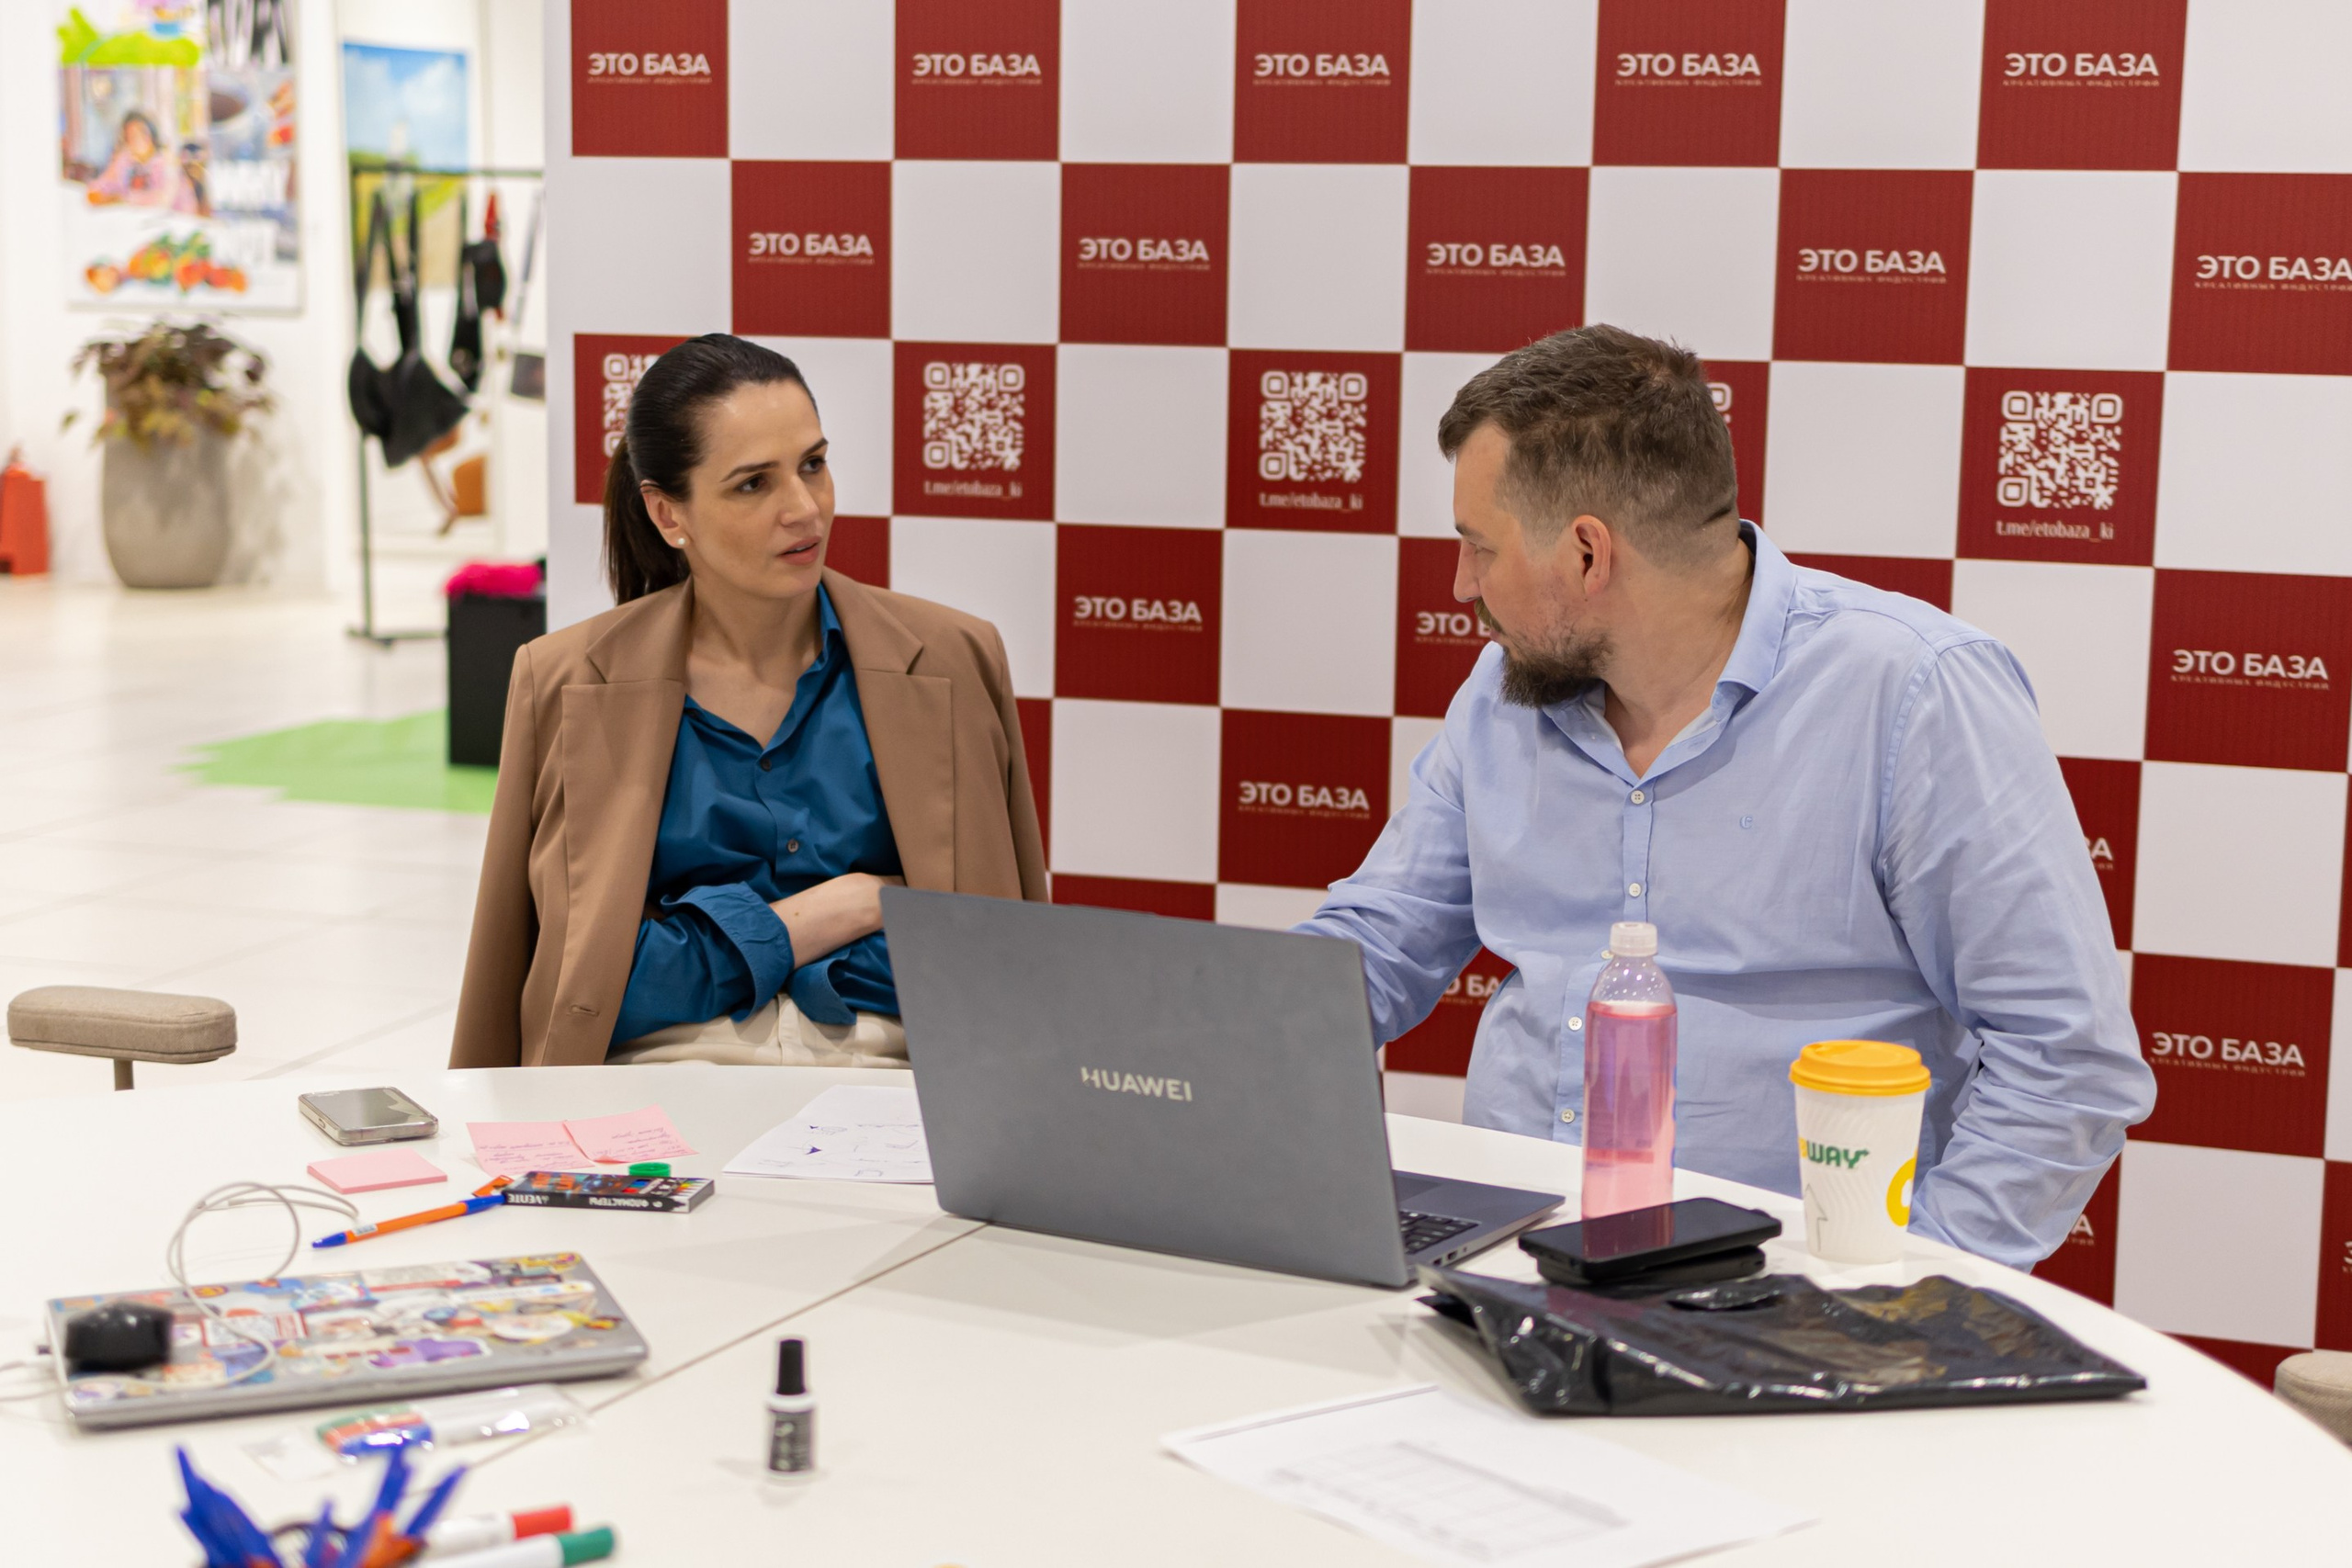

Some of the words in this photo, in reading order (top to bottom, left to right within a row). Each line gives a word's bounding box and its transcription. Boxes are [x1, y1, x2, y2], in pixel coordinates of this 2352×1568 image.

[588, 52, 639, 75] ЭТО
[642, 53, 711, 75] БАЗА
[912, 53, 966, 76] ЭТО
[969, 53, 1041, 76] БАЗА
[1254, 53, 1310, 76] ЭТО
[1315, 53, 1390, 76] БАЗА
[1616, 53, 1676, 76] ЭТО
[1681, 53, 1761, 76] БАЗА
[2004, 52, 2067, 77] ЭТО
[2074, 52, 2159, 76] БАЗА
[749, 232, 800, 255] ЭТО
[804, 233, 874, 256] БАЗА
[1079, 238, 1132, 261] ЭТО
[1137, 239, 1209, 262] БАЗА
[1427, 243, 1483, 266] ЭТО
[1488, 244, 1565, 267] БАЗА
[1798, 248, 1858, 273] ЭТО
[1865, 250, 1946, 274] БАЗА
[2196, 254, 2260, 279] ЭТО
[2267, 256, 2352, 281] БАЗА
[1074, 595, 1126, 621] ЭТО
[1131, 599, 1203, 624] БАЗА
[1417, 611, 1472, 637] ЭТО
[2172, 649, 2235, 675] ЭТО
[2244, 653, 2329, 680] БАЗА
[1238, 781, 1292, 807] ЭТО
[1297, 784, 1370, 810] БАЗА
[2151, 1032, 2213, 1059] ЭТО
[2221, 1037, 2305, 1067] БАЗА
[1080, 1066, 1193, 1102] HUAWEI
